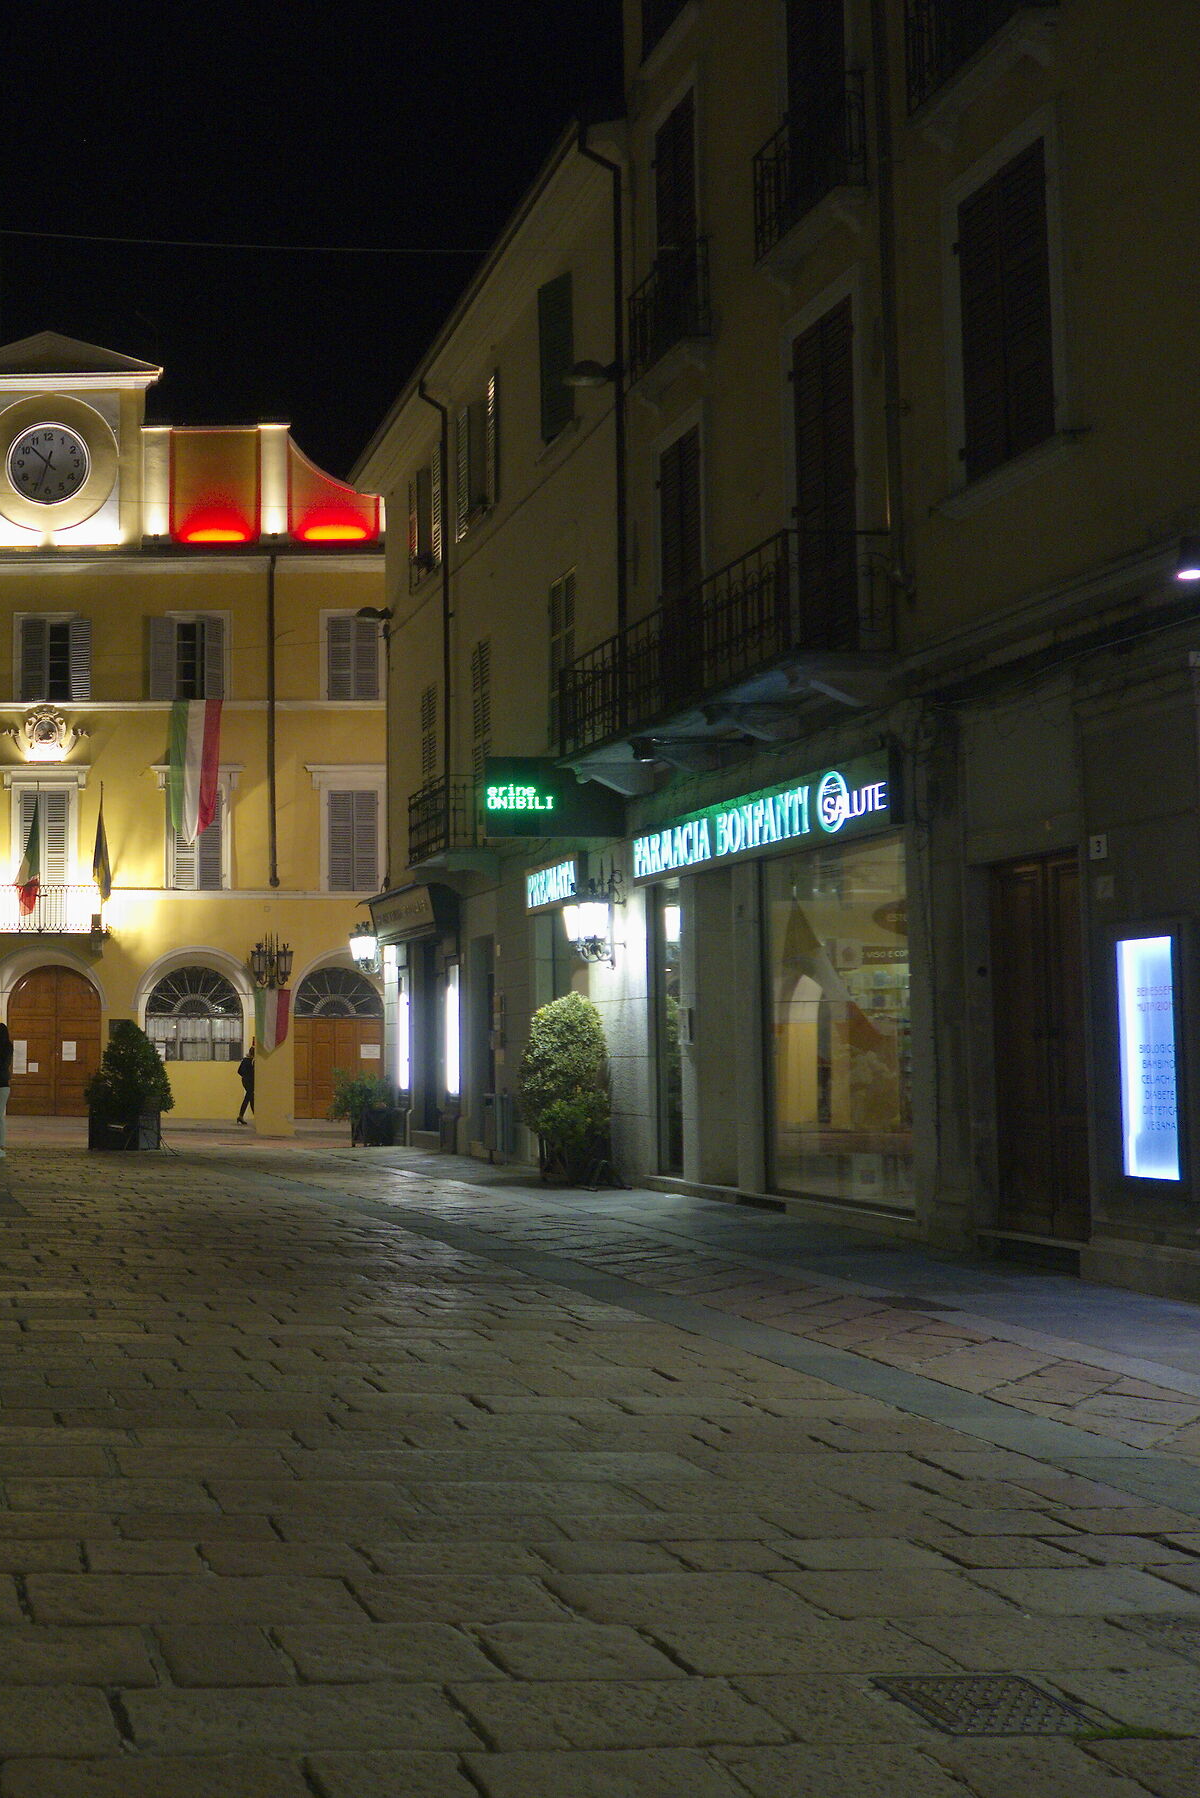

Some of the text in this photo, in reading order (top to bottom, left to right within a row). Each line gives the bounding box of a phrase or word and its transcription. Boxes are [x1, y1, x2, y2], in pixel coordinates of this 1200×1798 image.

[43, 432, 54, 441] 12
[32, 437, 39, 445] 11
[21, 446, 31, 455] 10
[69, 446, 76, 454] 2
[17, 460, 25, 468] 9
[73, 460, 80, 468] 3
[22, 473, 29, 481] 8
[32, 483, 39, 491] 7
[59, 483, 65, 491] 5
[487, 784, 536, 797] erine
[487, 796, 554, 809] ONIBILI
[633, 782, 887, 878] FARMACIA BONFANTI SALUTE
[1139, 1043, 1175, 1054] BIOLOGIC
